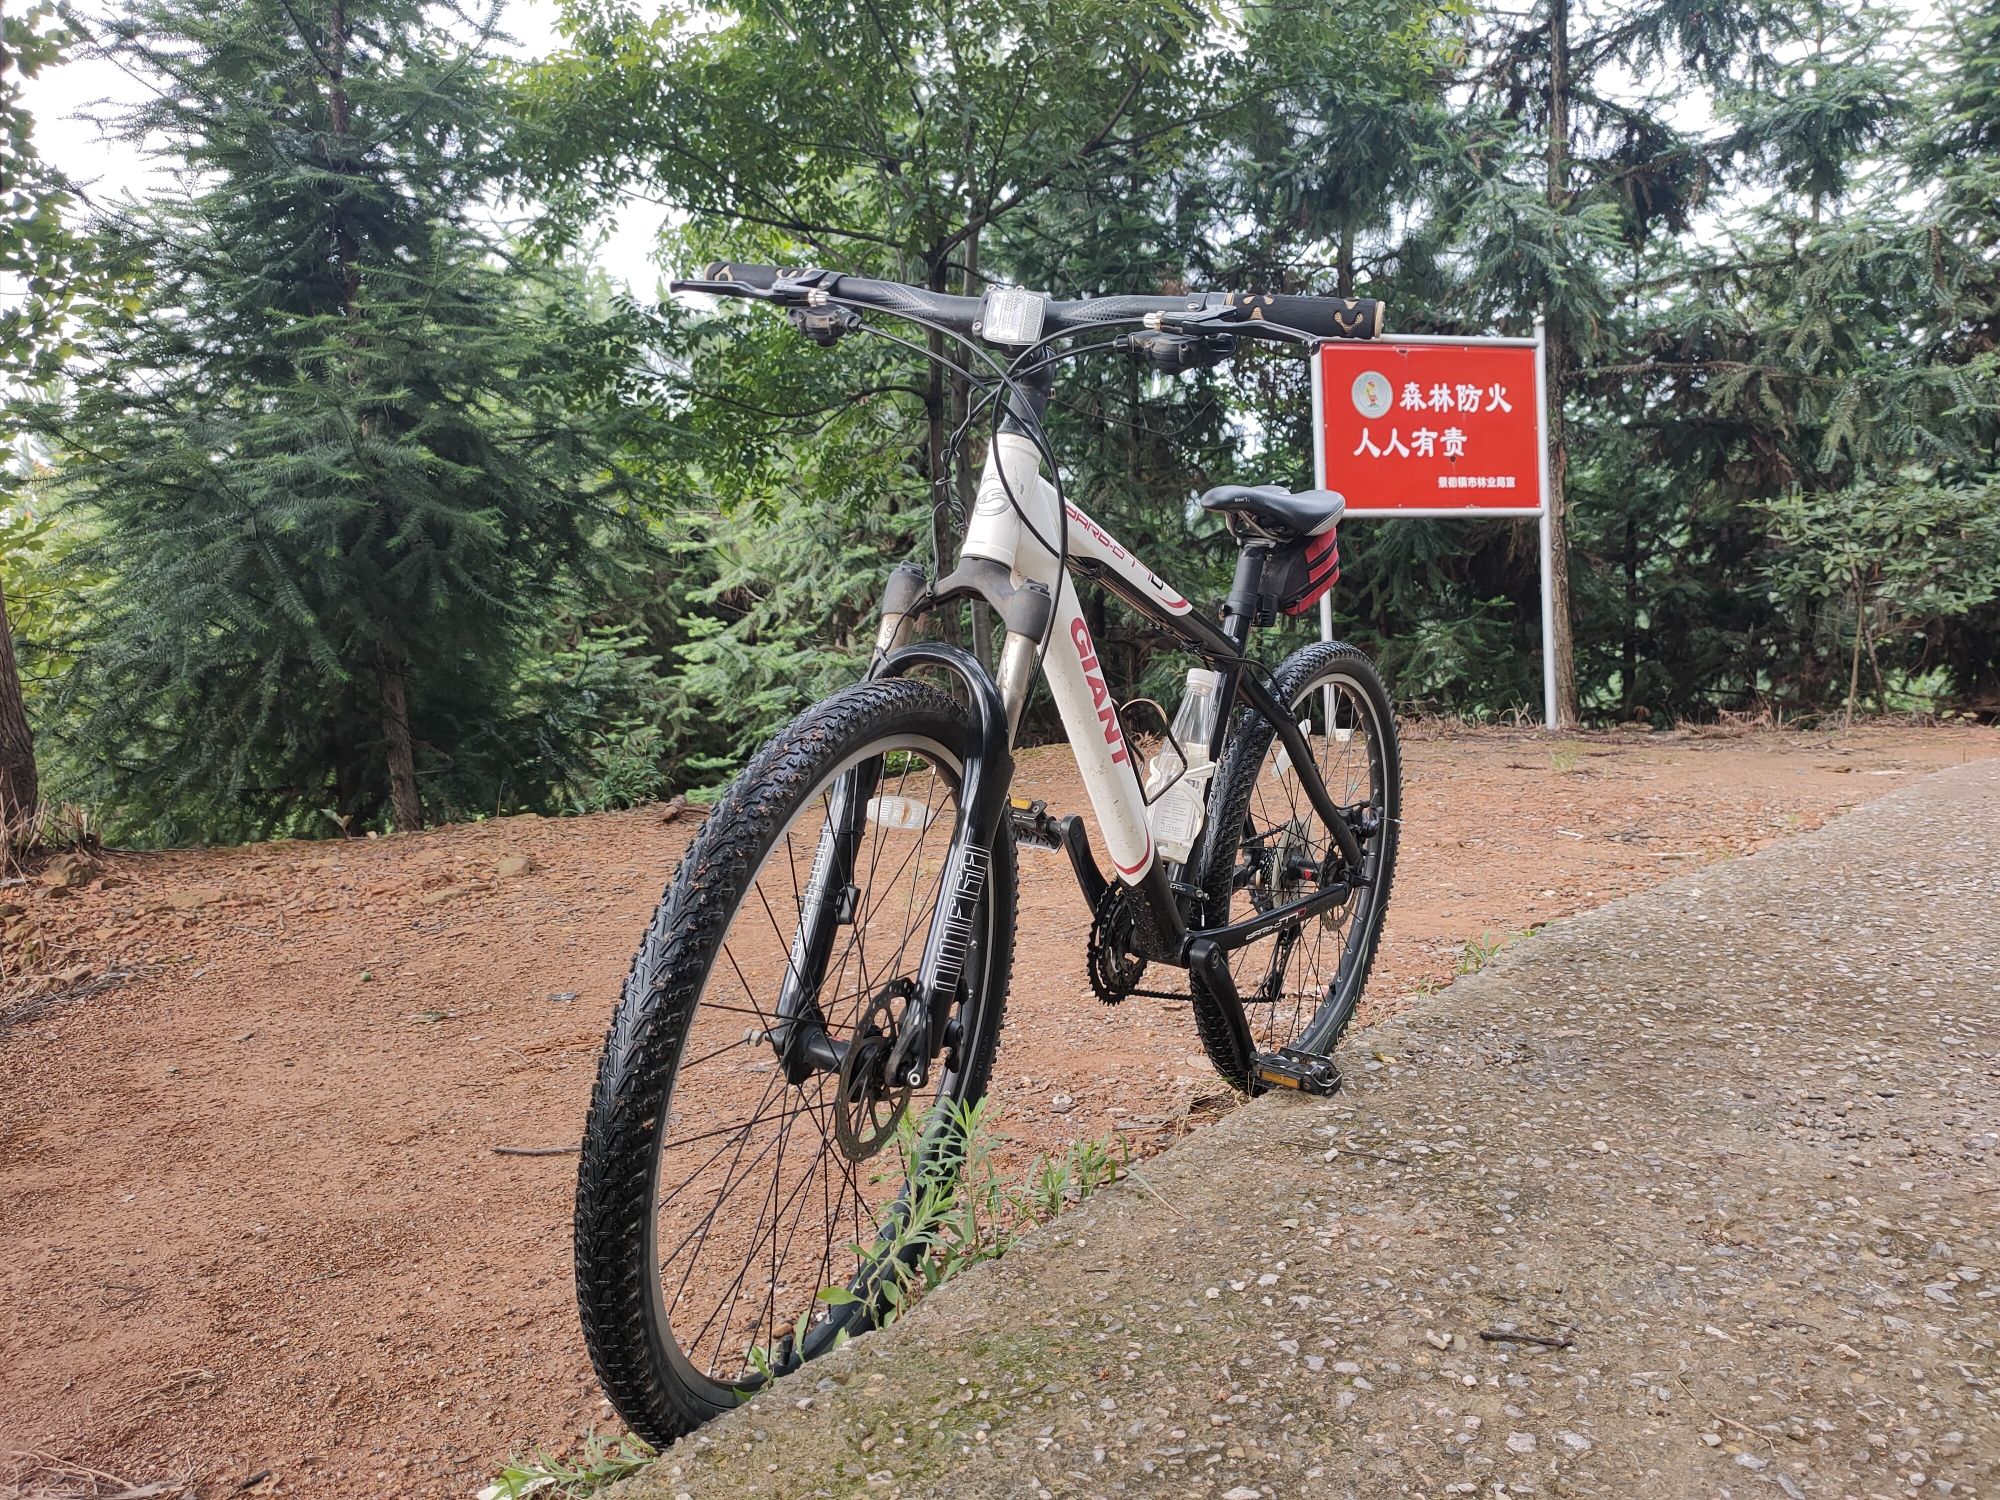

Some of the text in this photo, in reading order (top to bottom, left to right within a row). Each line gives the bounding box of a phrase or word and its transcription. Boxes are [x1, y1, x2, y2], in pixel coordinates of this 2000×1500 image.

[1399, 381, 1513, 413] 森林防火
[1353, 427, 1468, 458] 人人有责
[1070, 616, 1130, 768] GIANT
